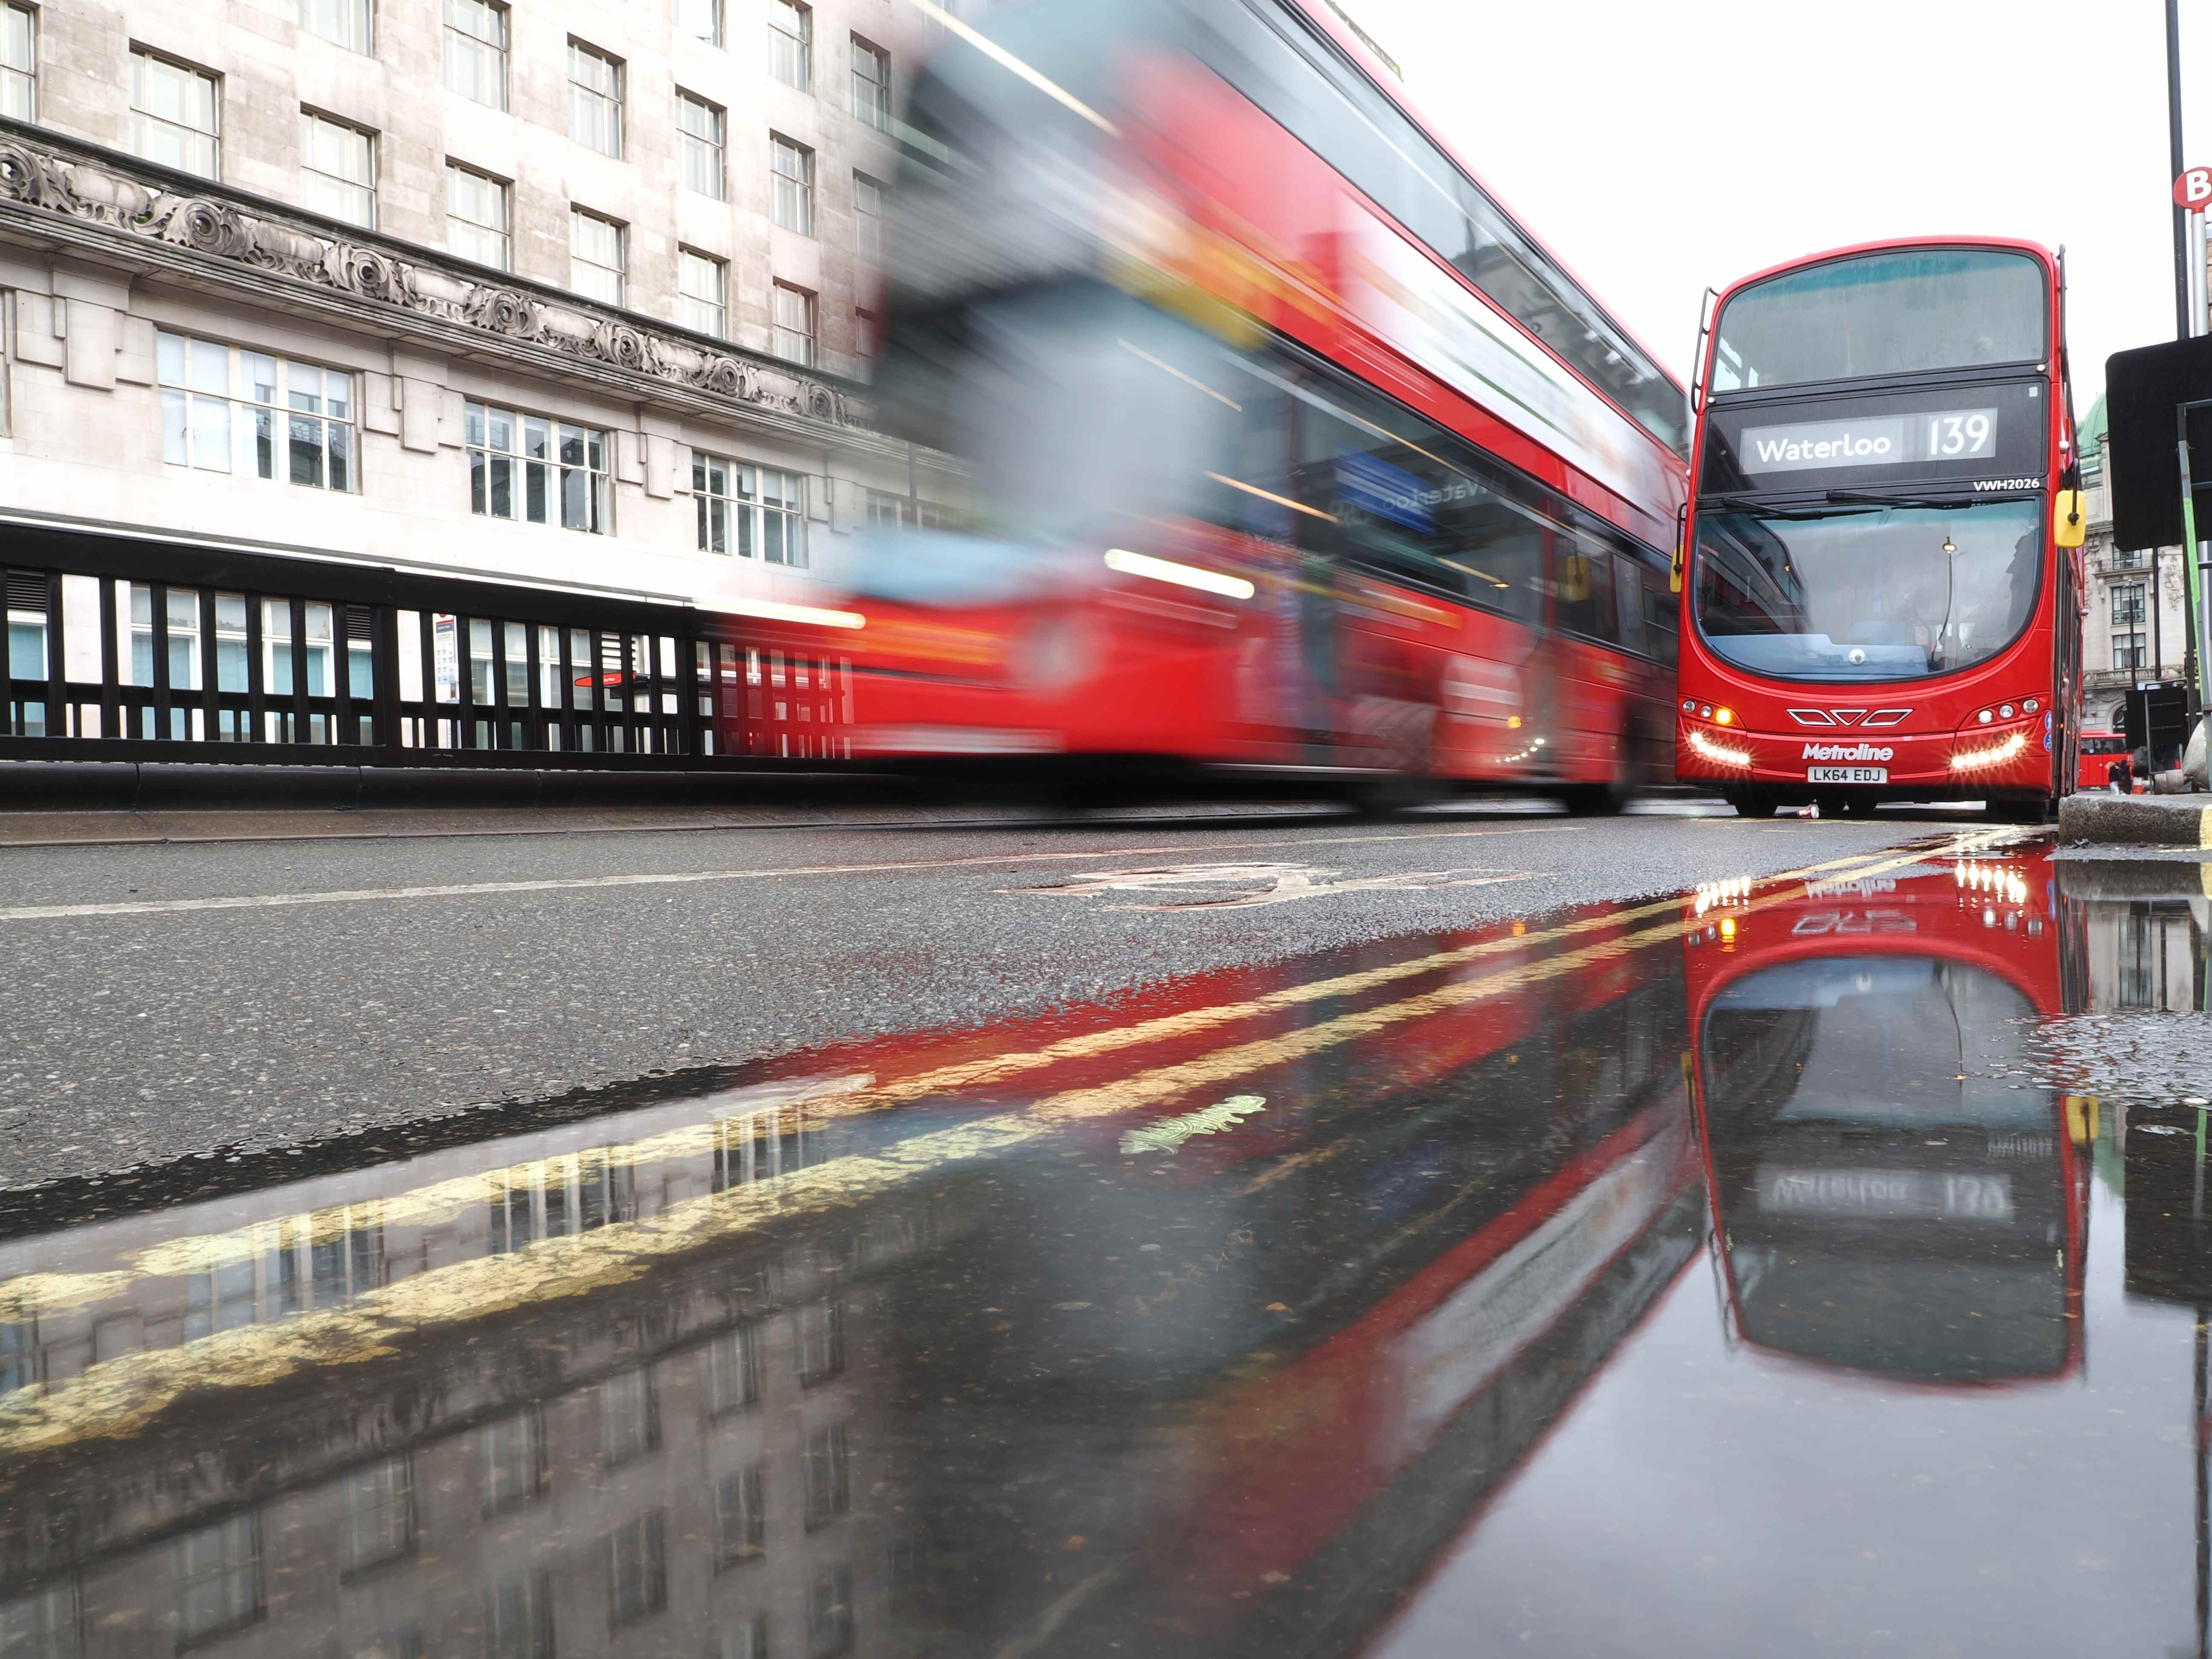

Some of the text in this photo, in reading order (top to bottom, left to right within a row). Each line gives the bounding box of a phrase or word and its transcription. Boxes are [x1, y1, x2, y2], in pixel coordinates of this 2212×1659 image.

[2186, 170, 2211, 202] B
[1756, 414, 1989, 462] Waterloo 139
[1973, 478, 2040, 492] VWH2026
[1802, 742, 1894, 761] Metroline
[1814, 769, 1880, 781] LK64 EDJ
